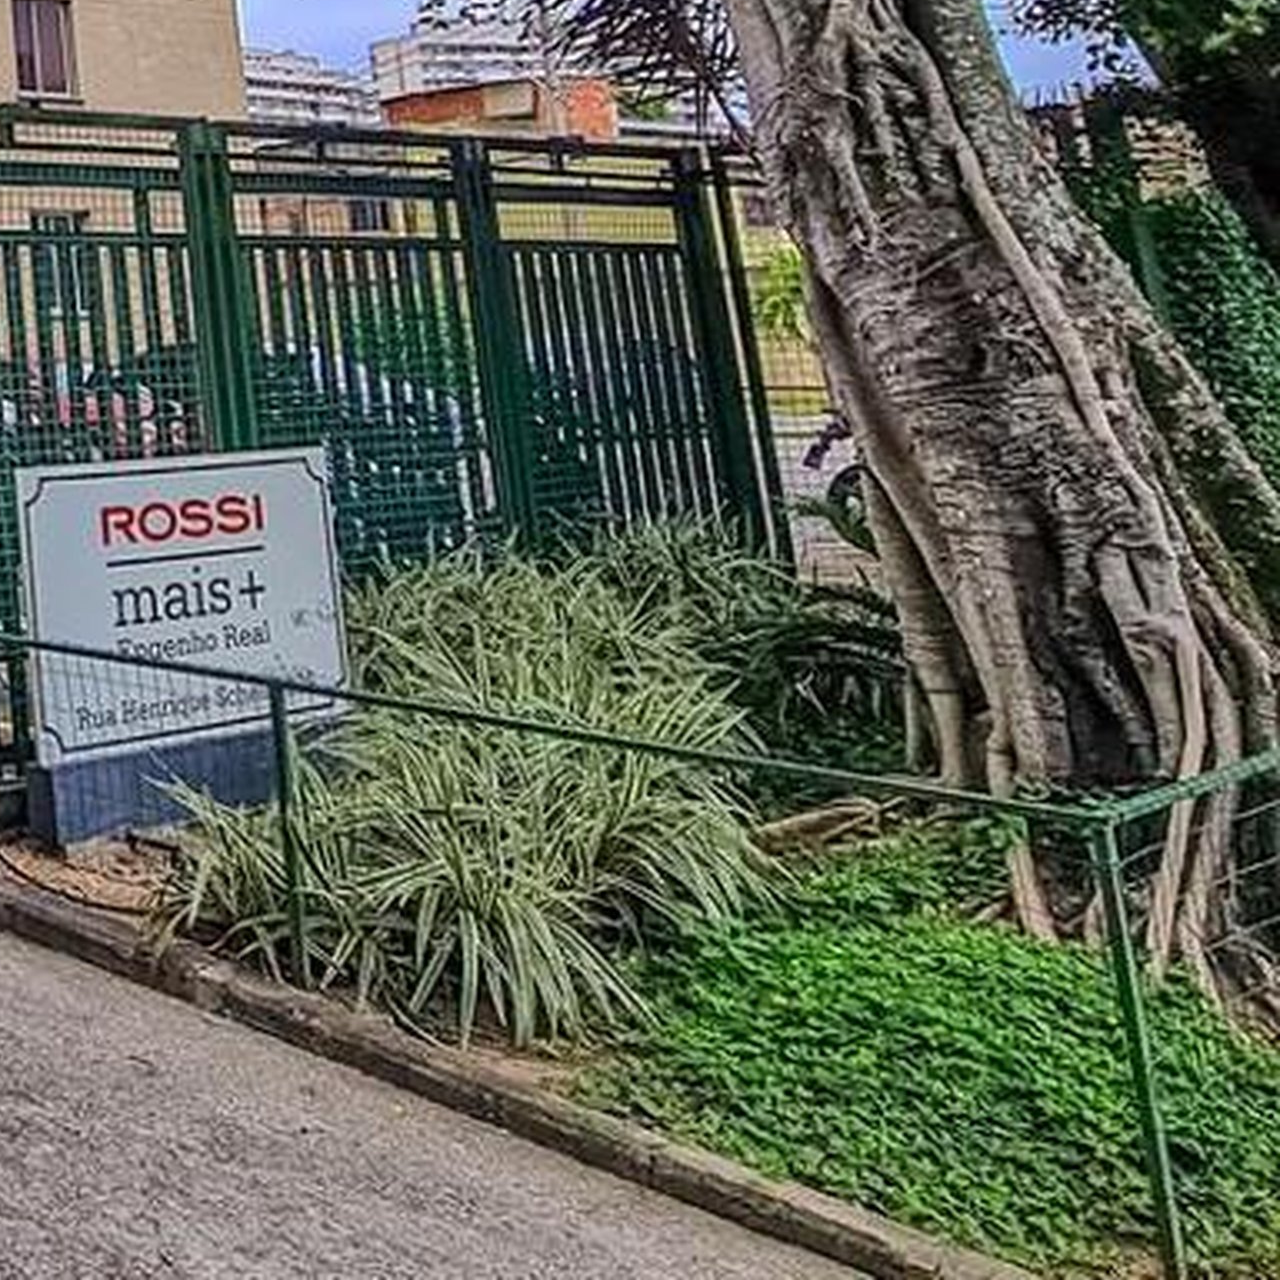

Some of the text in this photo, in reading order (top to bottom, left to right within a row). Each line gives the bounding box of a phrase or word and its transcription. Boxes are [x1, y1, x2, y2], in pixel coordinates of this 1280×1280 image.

[101, 494, 264, 546] ROSSI
[116, 618, 272, 662] Engenho Real
[75, 705, 118, 731] Rua
[120, 691, 211, 724] Henrique
